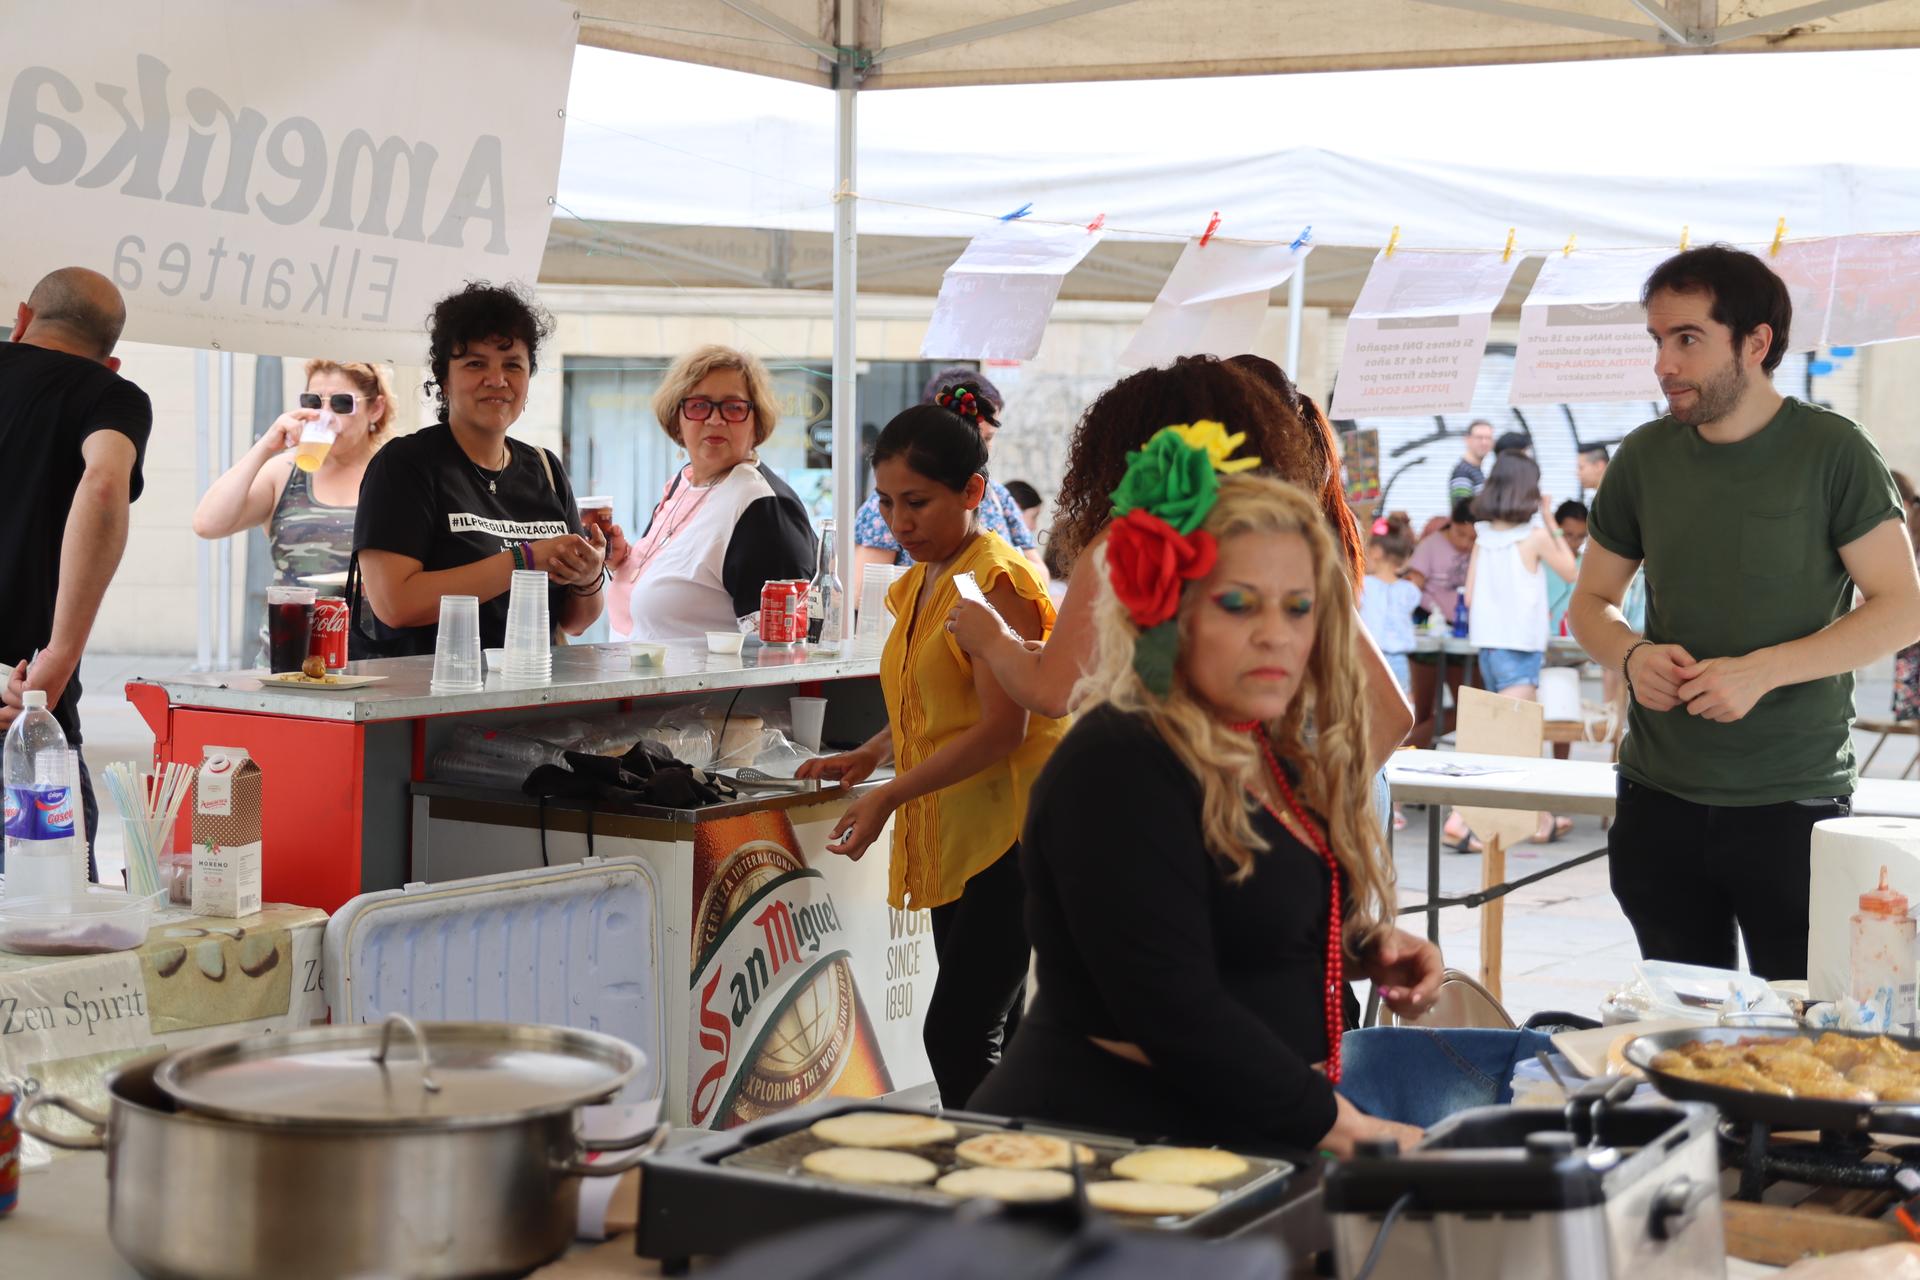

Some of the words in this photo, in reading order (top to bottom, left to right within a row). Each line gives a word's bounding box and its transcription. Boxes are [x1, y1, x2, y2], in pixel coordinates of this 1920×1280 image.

[198, 860, 229, 869] MORENO
[705, 878, 734, 944] CERVEZA
[888, 906, 932, 941] WOR
[303, 959, 324, 993] Ze
[886, 940, 921, 982] SINCE
[0, 997, 56, 1036] Zen
[63, 982, 145, 1036] Spirit
[691, 947, 770, 1126] San
[753, 892, 842, 976] Miguel
[885, 981, 913, 1022] 1890
[745, 1073, 801, 1103] XPLORING
[803, 1064, 821, 1089] THE
[820, 1029, 843, 1072] WORLD
[838, 992, 850, 1032] SINCE
